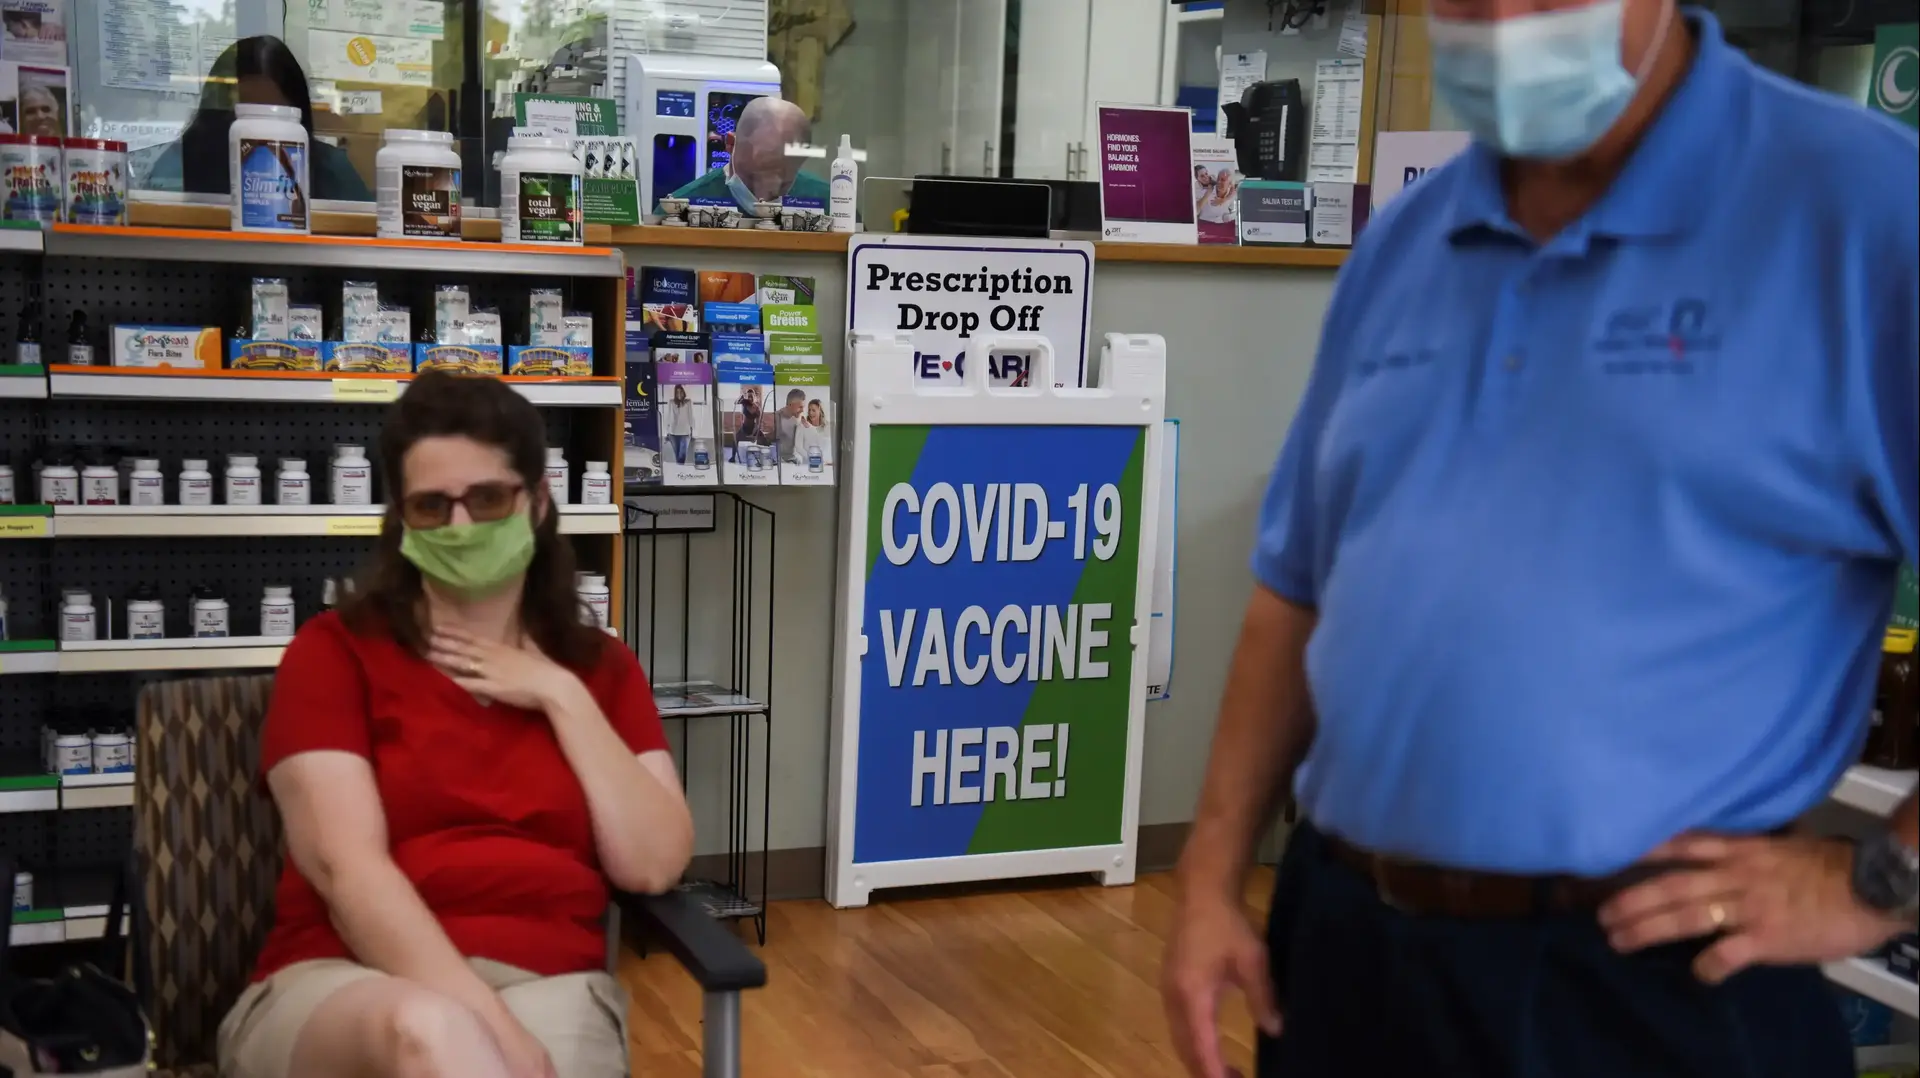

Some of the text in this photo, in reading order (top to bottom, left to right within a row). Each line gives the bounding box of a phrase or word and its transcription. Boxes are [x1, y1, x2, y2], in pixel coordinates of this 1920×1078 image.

[1106, 133, 1141, 143] HORMONES.
[1107, 143, 1138, 153] FIND YOUR
[1107, 153, 1140, 163] BALANCE &
[412, 191, 436, 202] total
[528, 196, 551, 208] total
[1281, 198, 1294, 206] TEST
[412, 201, 441, 212] vegan
[528, 206, 557, 218] vegan
[866, 263, 1073, 301] Prescription
[769, 314, 808, 327] Greens
[896, 303, 1044, 338] Drop Off
[881, 481, 1122, 566] COVID-19
[879, 602, 1113, 687] VACCINE
[910, 722, 1071, 807] HERE!
